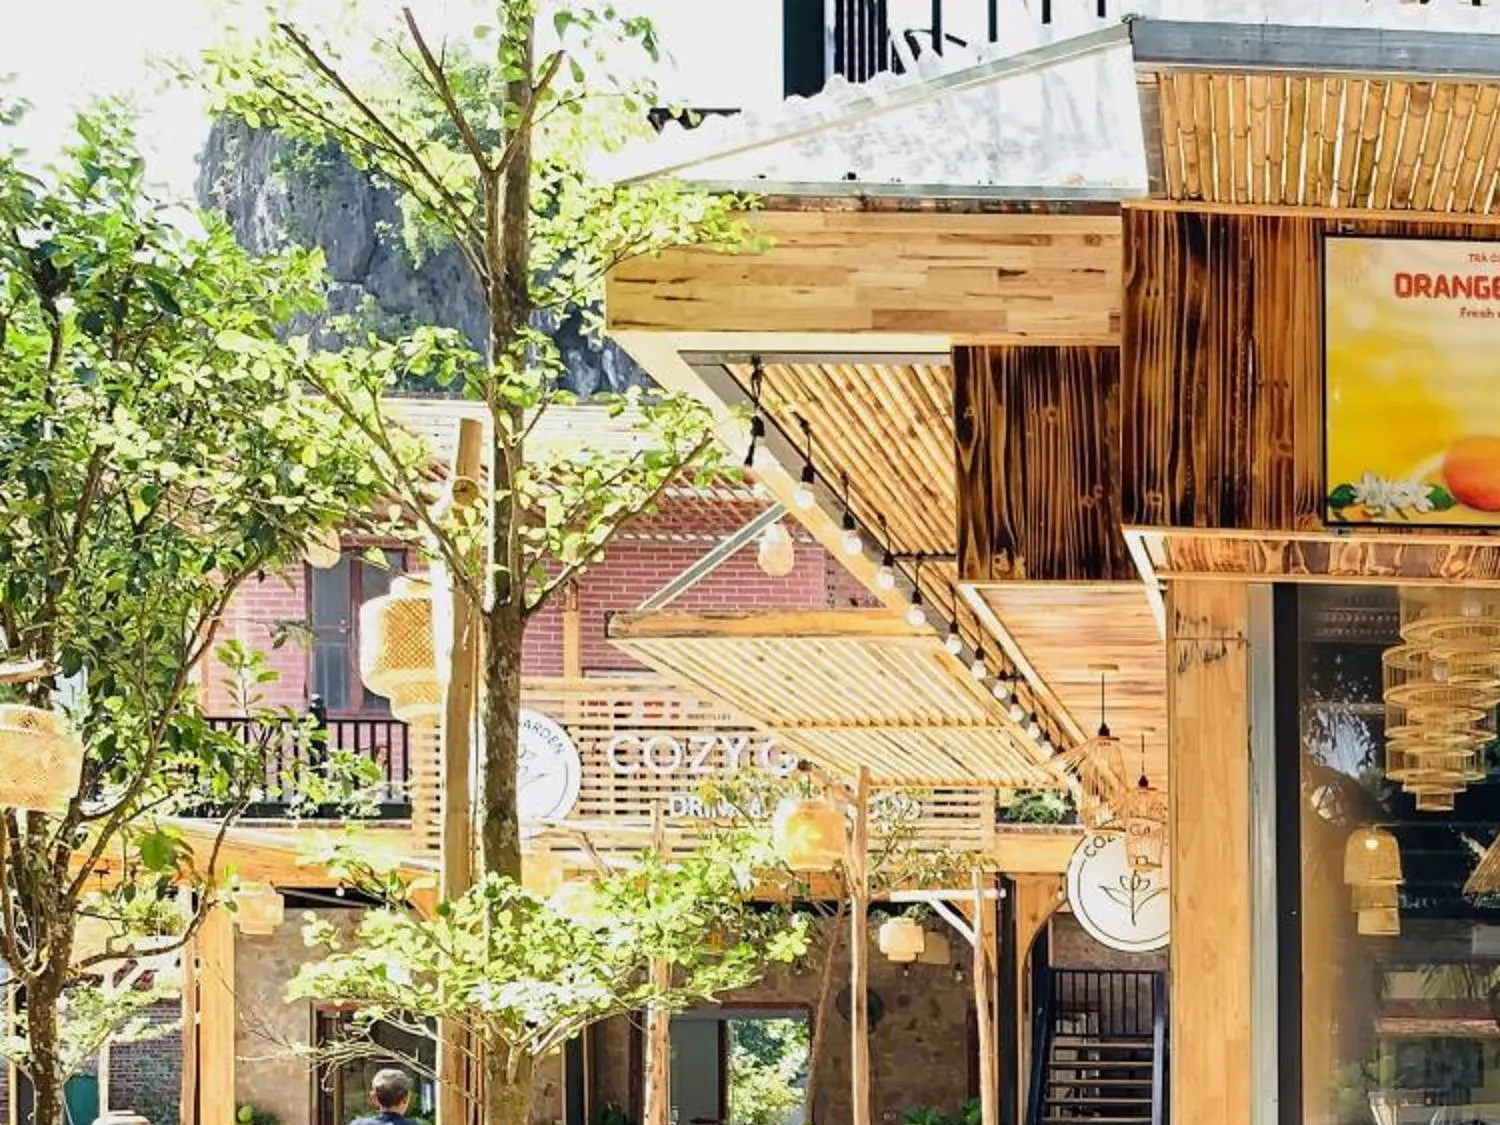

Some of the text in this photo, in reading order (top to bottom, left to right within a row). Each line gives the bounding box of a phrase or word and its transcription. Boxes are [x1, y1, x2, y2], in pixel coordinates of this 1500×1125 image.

[1460, 307, 1494, 319] Fresh
[523, 719, 565, 755] ARDEN
[607, 734, 750, 775] COZY
